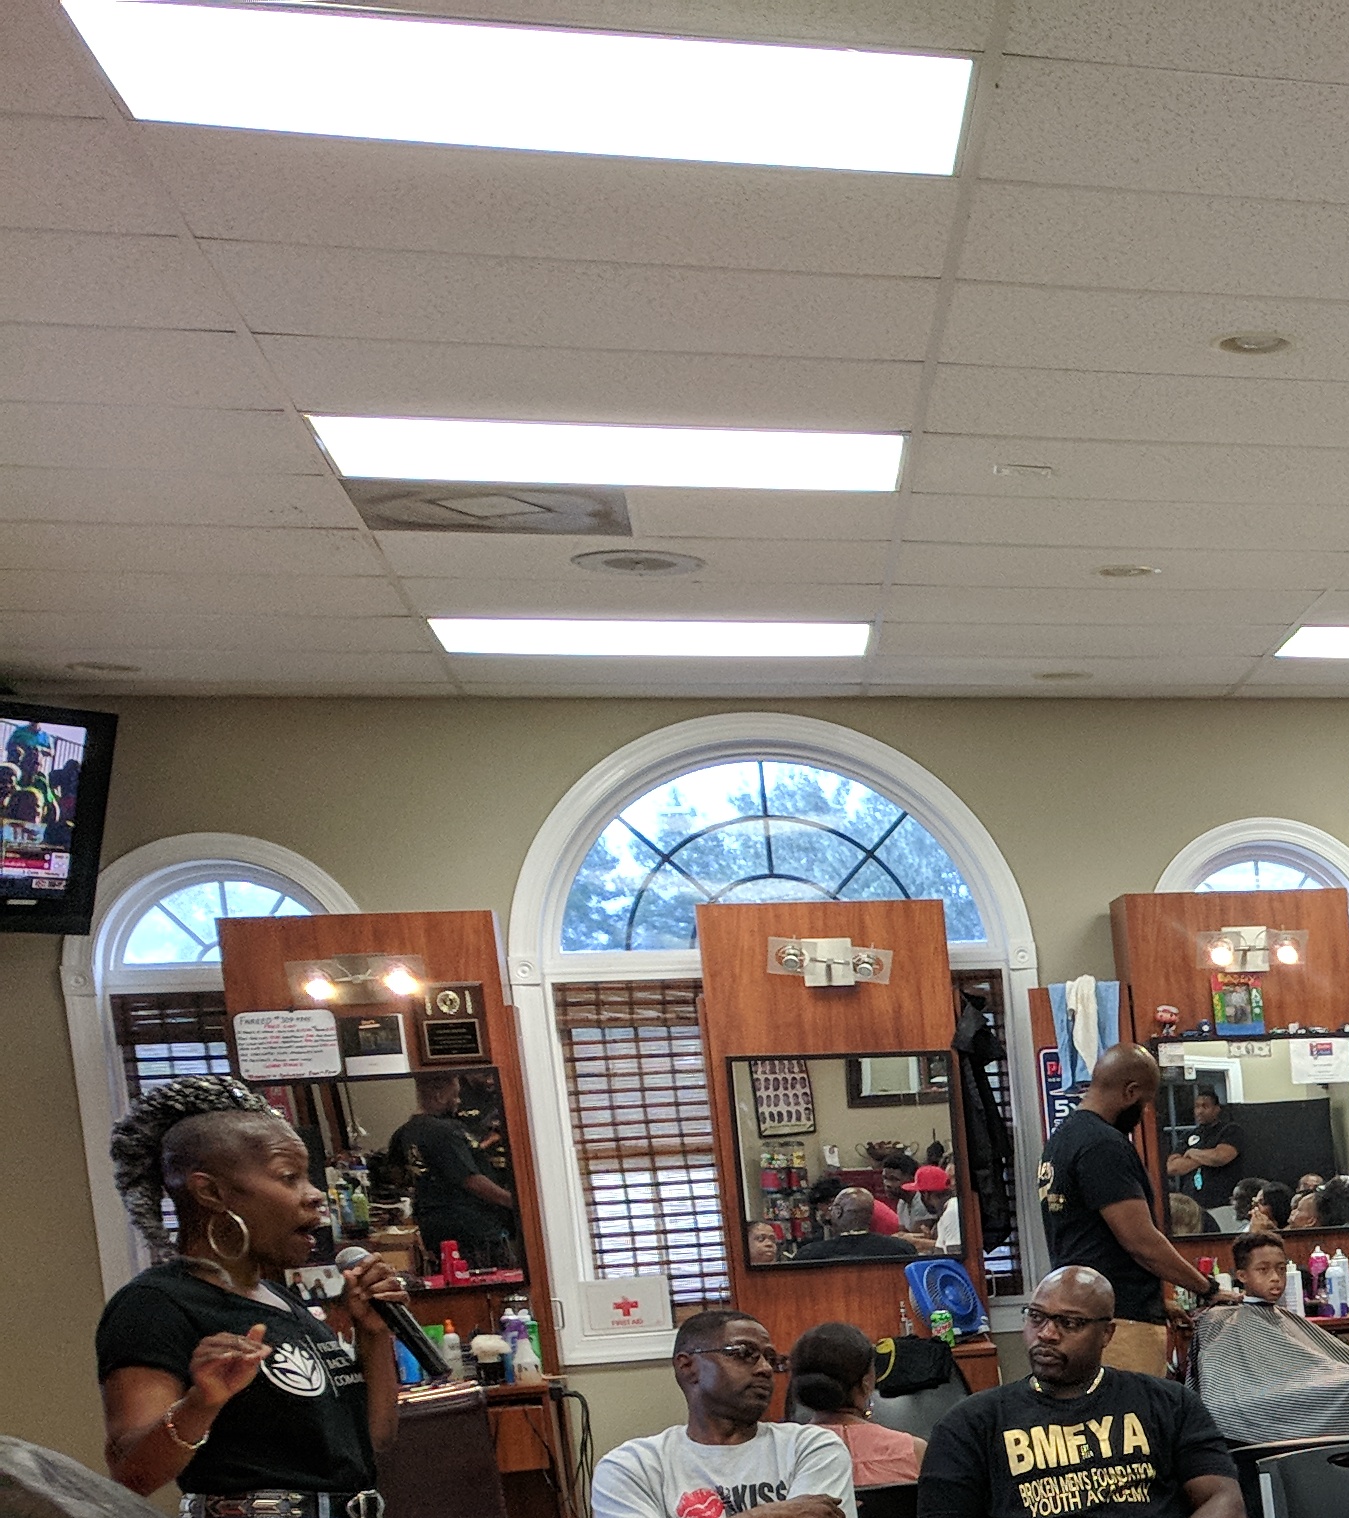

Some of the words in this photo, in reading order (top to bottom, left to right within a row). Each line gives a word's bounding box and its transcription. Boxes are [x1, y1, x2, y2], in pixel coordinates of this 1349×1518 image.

[1019, 1476, 1060, 1508] BROKEN
[1030, 1490, 1082, 1518] YOUTH
[1086, 1482, 1151, 1507] ACADEMY
